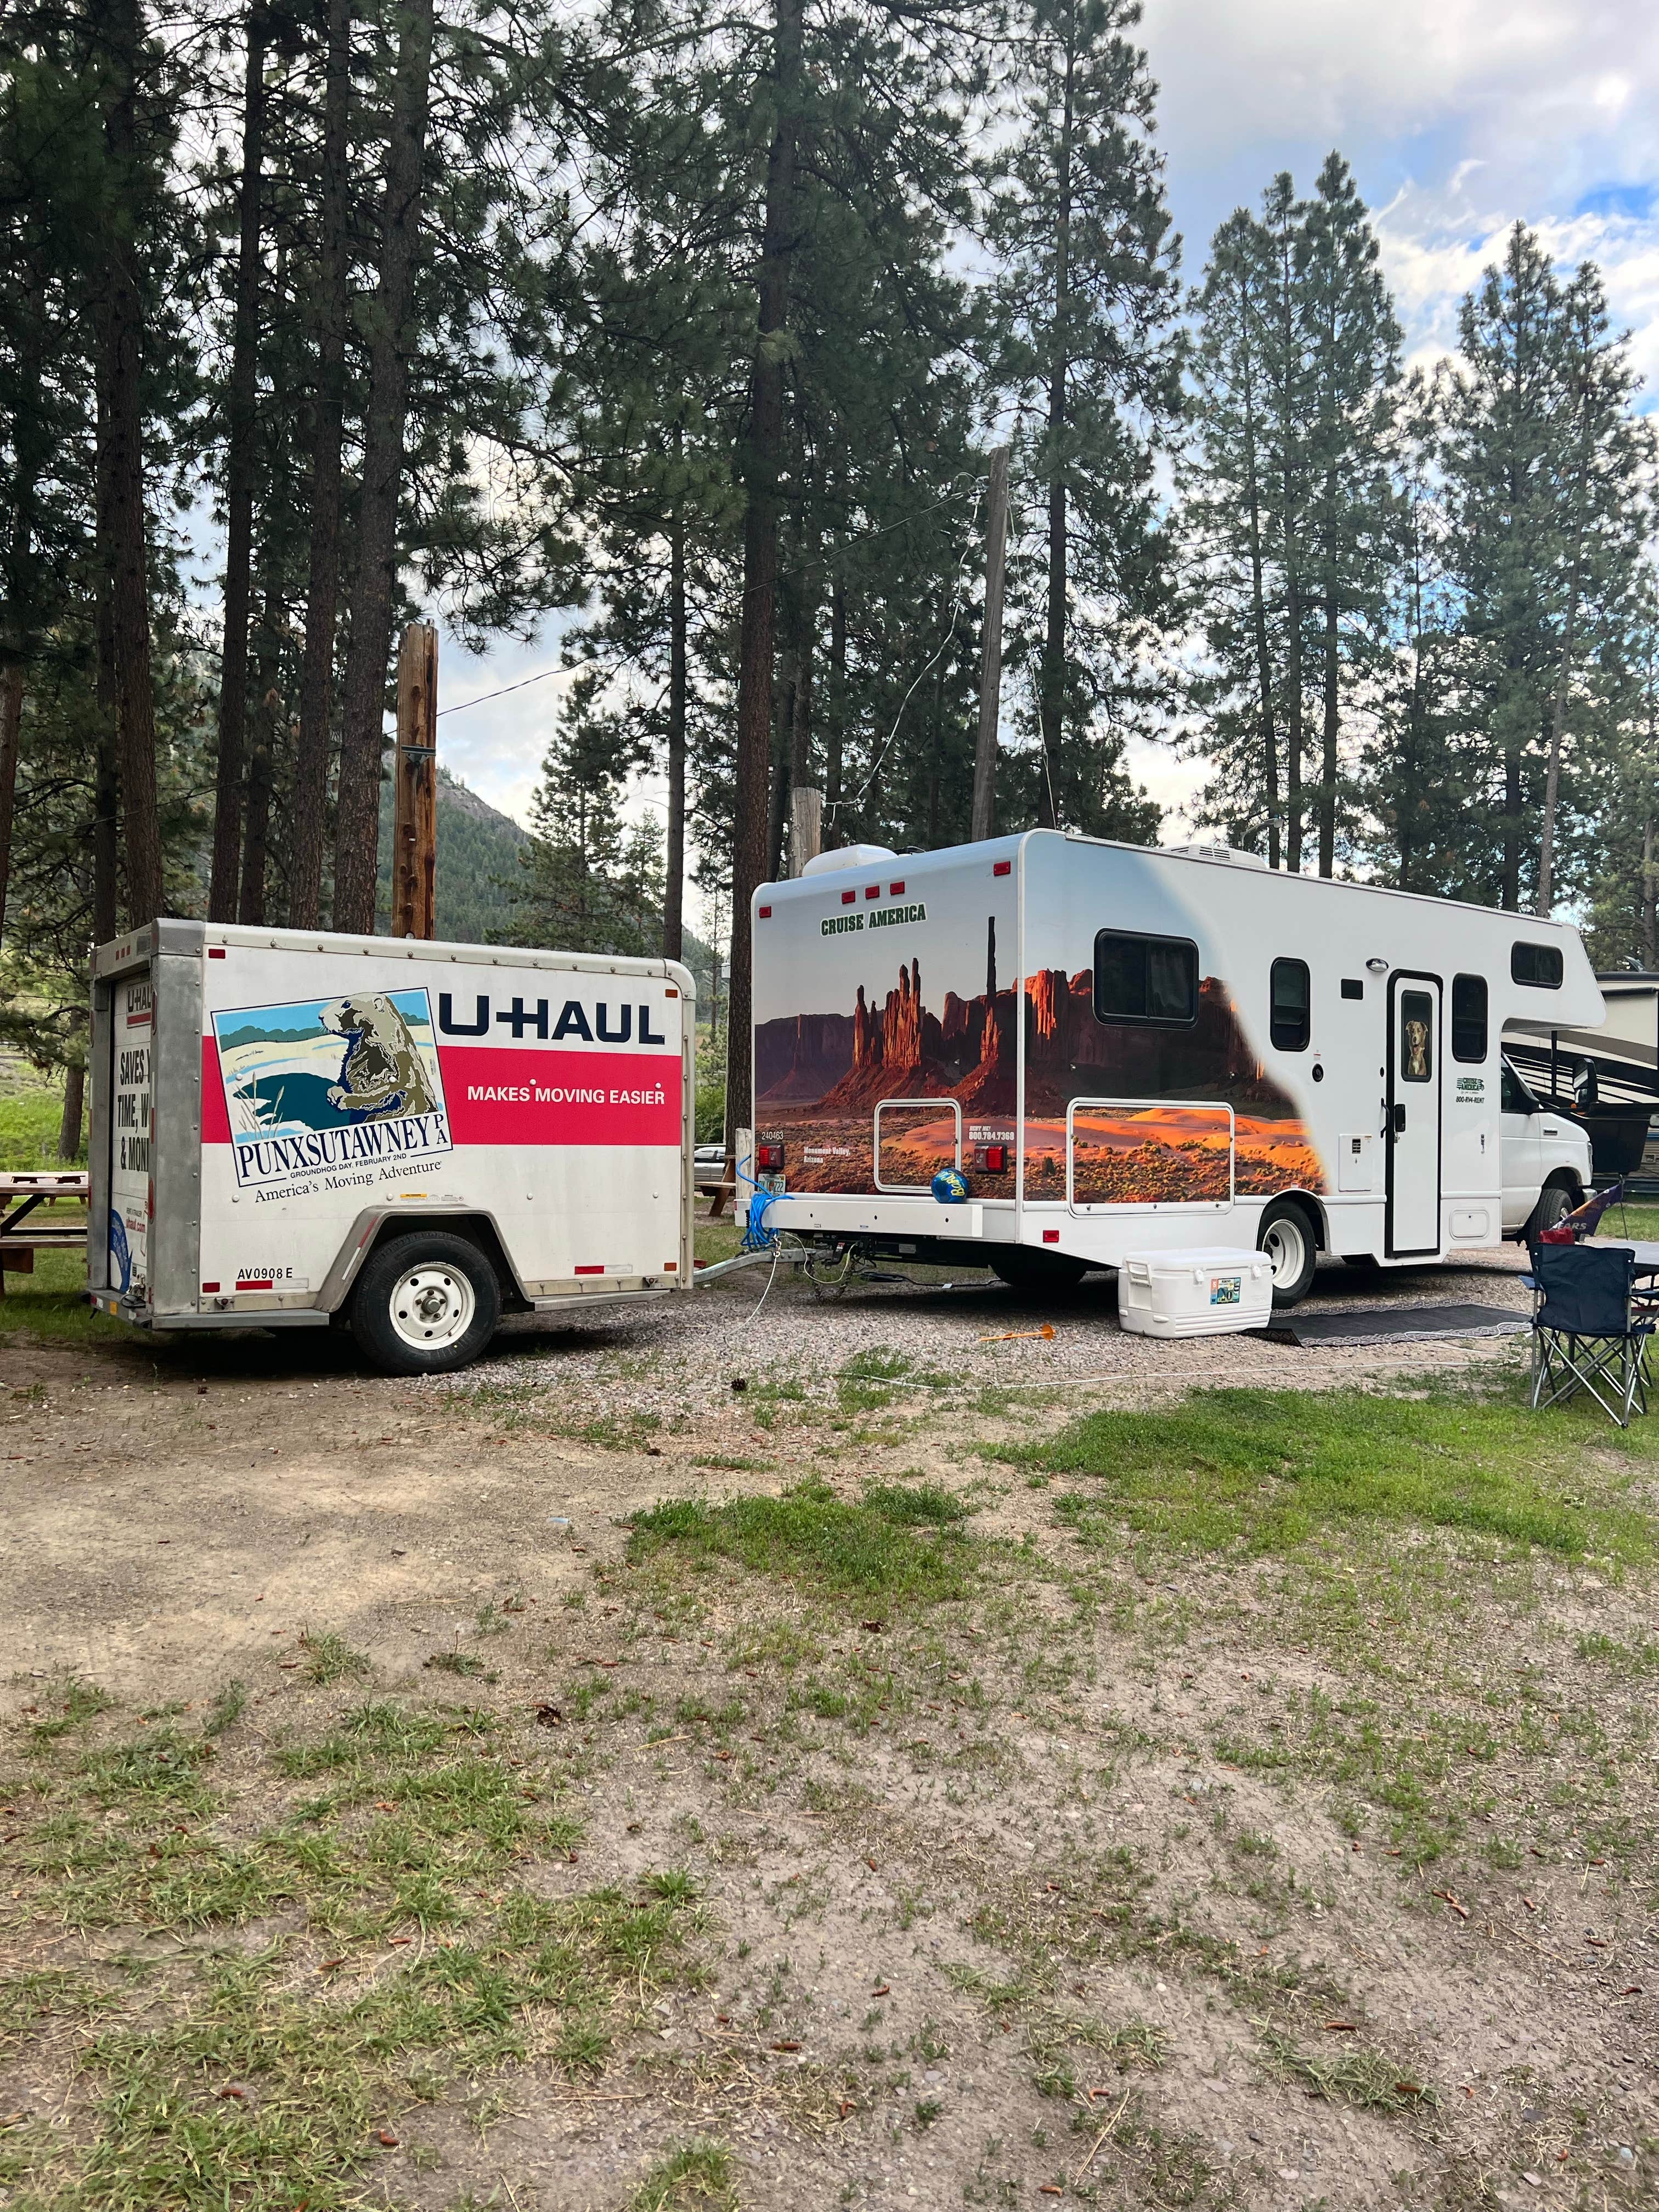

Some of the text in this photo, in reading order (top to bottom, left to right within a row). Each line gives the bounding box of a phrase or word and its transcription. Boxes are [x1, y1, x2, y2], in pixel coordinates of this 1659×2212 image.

[821, 904, 926, 936] CRUISE AMERICA
[439, 993, 665, 1045] U-HAUL
[120, 1048, 144, 1086] SAVES
[467, 1086, 665, 1104] MAKES MOVING EASIER
[117, 1094, 138, 1133] TIME,
[236, 1115, 430, 1178] PUNXSUTAWNEY
[761, 1131, 783, 1140] 240463
[968, 1131, 1015, 1141] 800.784.7368
[121, 1136, 149, 1172] & MON
[290, 1164, 337, 1178] GROUNDHOG
[356, 1156, 392, 1167] FEBRUARY
[393, 1153, 407, 1161] 2ND
[255, 1181, 319, 1203] America's
[325, 1172, 374, 1190] Moving
